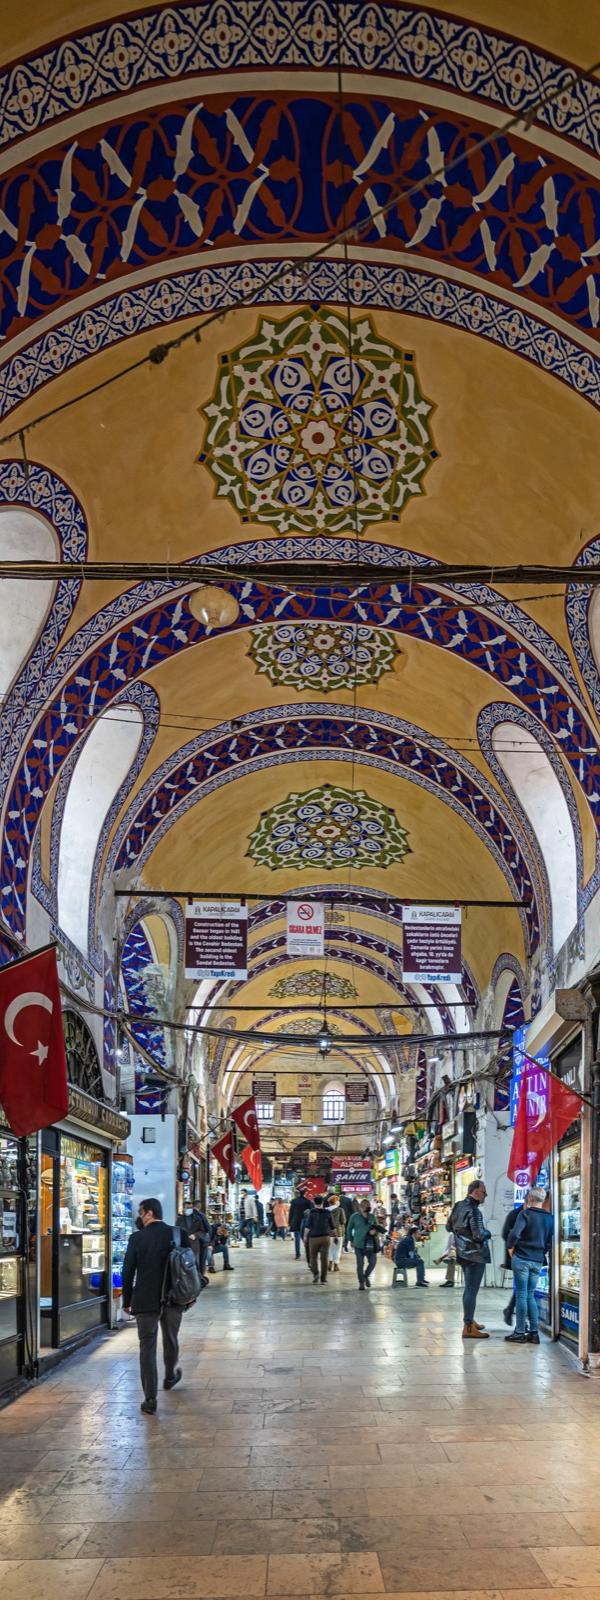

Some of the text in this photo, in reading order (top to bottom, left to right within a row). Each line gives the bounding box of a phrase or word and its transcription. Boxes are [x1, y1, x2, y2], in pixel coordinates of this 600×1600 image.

[512, 1072, 547, 1100] ATIN
[335, 1172, 368, 1181] ŞAHİN
[518, 1174, 528, 1185] 22
